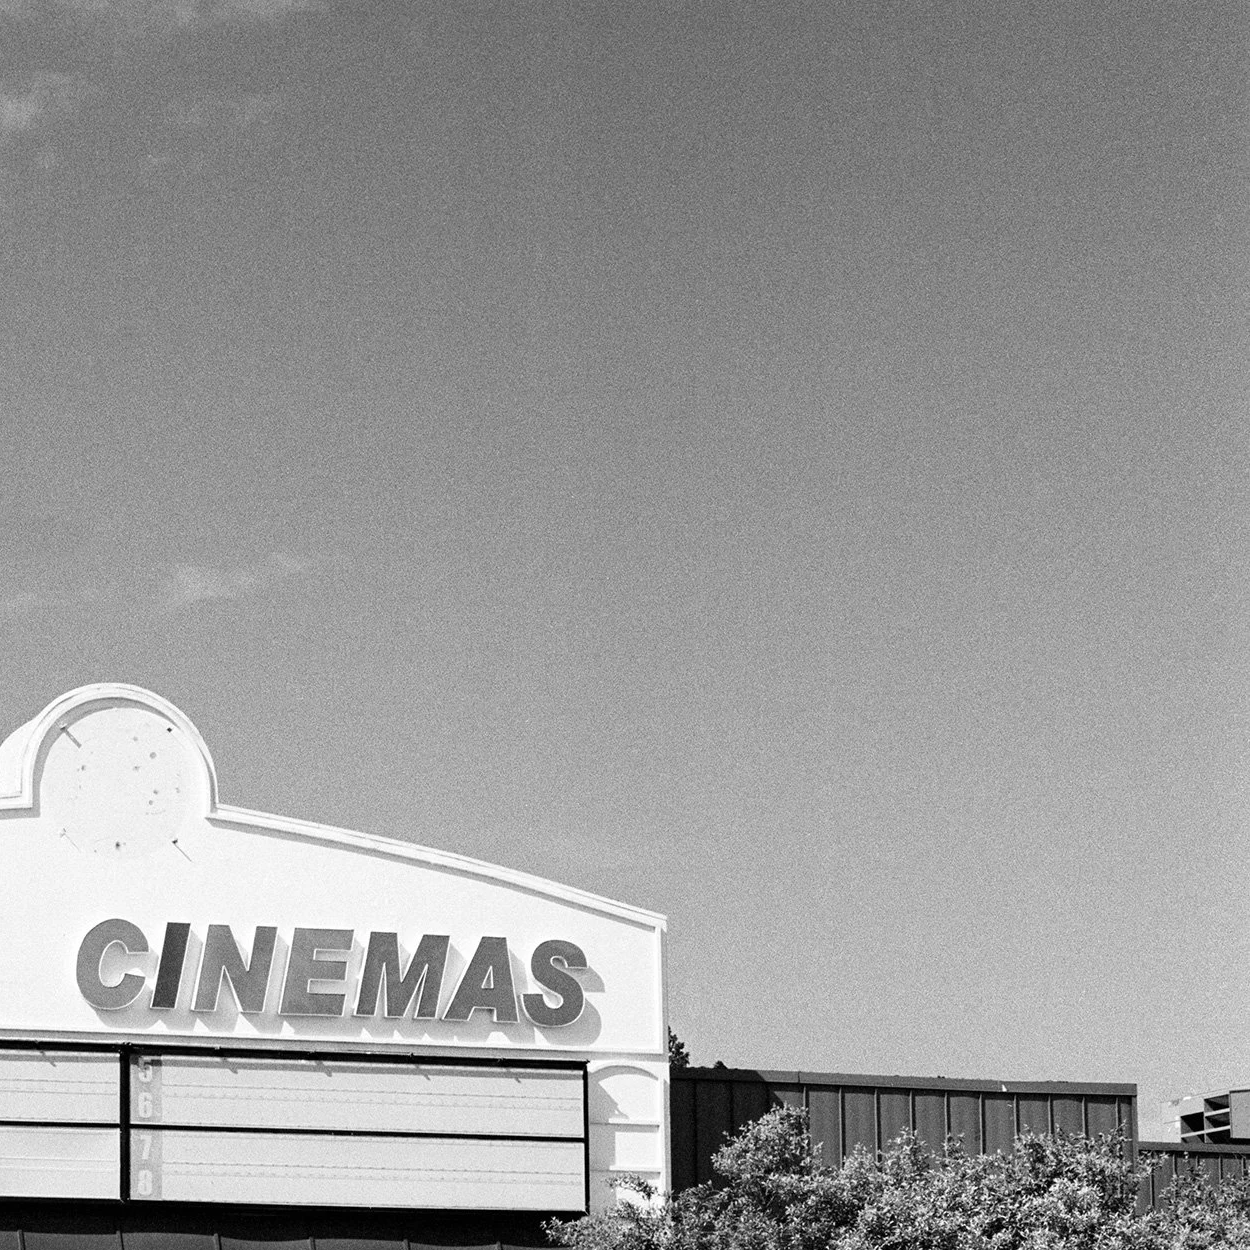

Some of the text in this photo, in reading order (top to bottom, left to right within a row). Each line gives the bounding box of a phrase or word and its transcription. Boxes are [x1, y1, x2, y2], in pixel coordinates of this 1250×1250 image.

[76, 918, 589, 1027] CINEMAS
[138, 1092, 153, 1118] 6
[141, 1135, 152, 1160] 7
[138, 1170, 153, 1195] 8
